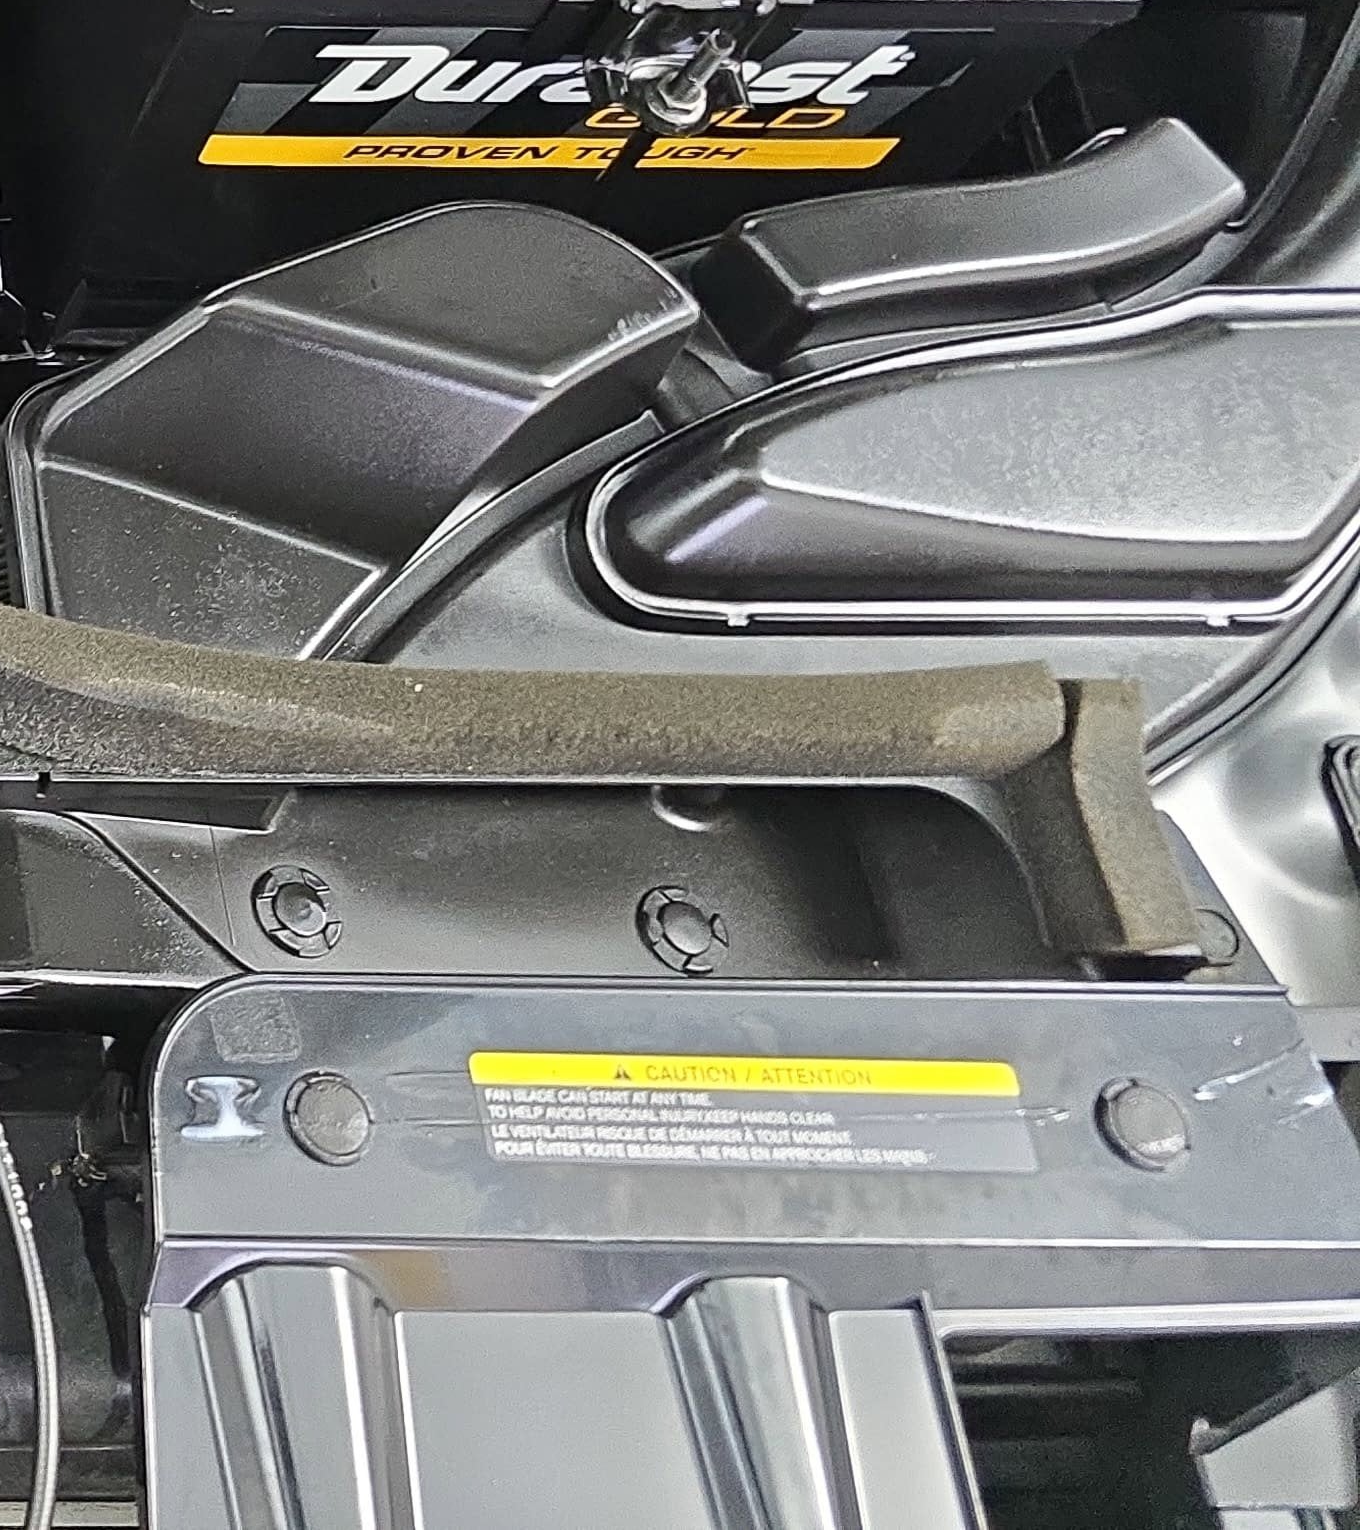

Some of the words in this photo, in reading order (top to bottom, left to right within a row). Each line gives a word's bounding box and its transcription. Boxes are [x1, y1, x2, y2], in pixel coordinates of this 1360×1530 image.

[308, 44, 914, 105] Durast
[585, 107, 846, 129] GLD
[344, 144, 553, 161] PROVEN
[644, 1064, 737, 1083] CAUTION
[761, 1067, 872, 1086] ATTENTION
[484, 1088, 511, 1102] FAN
[512, 1088, 557, 1103] BLADE
[558, 1089, 587, 1103] CAN
[588, 1089, 630, 1104] START
[631, 1090, 648, 1104] AT
[650, 1091, 676, 1105] ANY
[487, 1105, 507, 1119] TO
[509, 1105, 544, 1120] HELP
[545, 1106, 586, 1120] AVOID
[586, 1107, 658, 1122] PERSONAL
[491, 1124, 509, 1138] LE
[509, 1125, 596, 1140] VENTILATEUR
[648, 1127, 668, 1141] DE
[756, 1130, 791, 1144] TOUT
[495, 1141, 534, 1156] POUR
[582, 1142, 626, 1158] TOUTE
[701, 1145, 721, 1159] NE
[721, 1145, 750, 1160] PAS
[751, 1146, 770, 1160] EN
